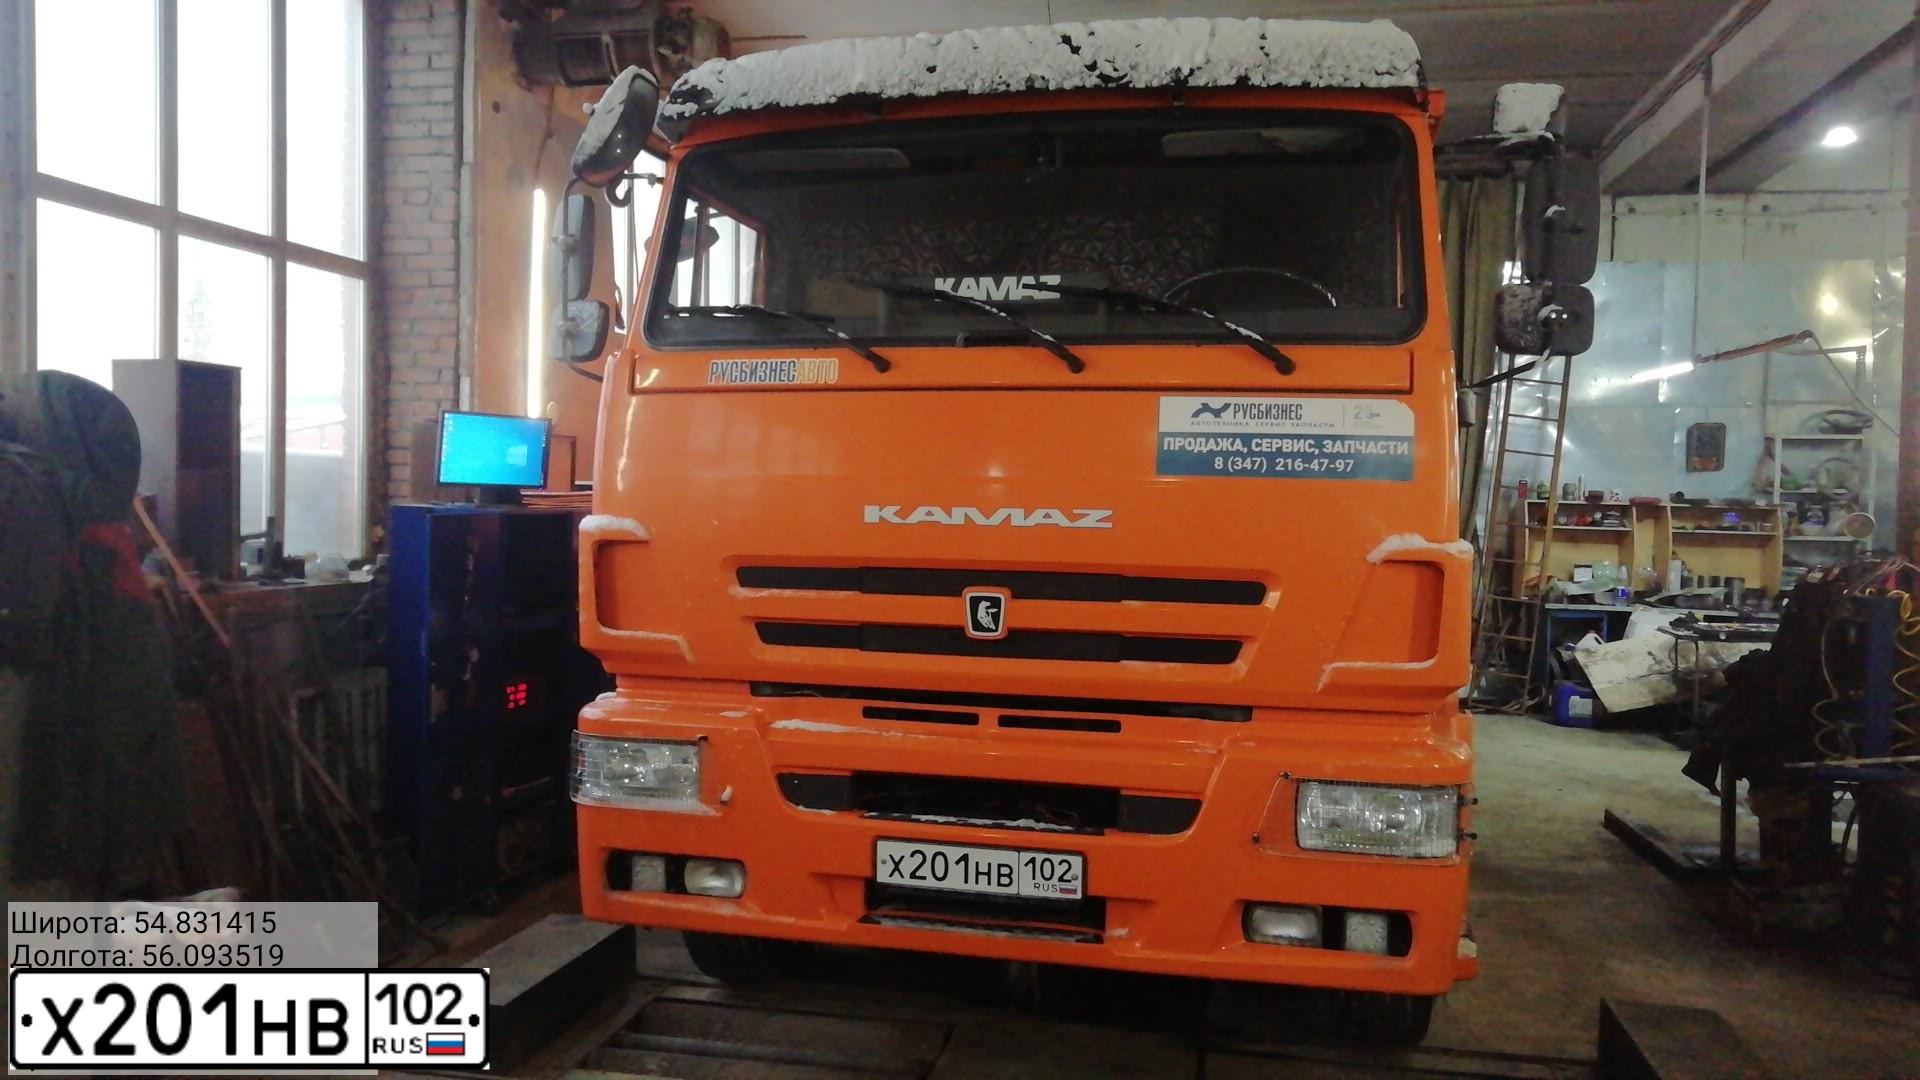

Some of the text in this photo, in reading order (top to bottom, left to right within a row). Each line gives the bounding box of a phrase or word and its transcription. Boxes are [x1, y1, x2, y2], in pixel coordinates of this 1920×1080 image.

[1233, 403, 1303, 420] РУСБИЗНЕС
[1163, 437, 1409, 455] ПРОДАЖА, СЕРВИС, ЗАПЧАСТИ
[1214, 457, 1354, 473] 8 (347) 216-47-97
[864, 505, 1113, 529] KAMAZ
[1023, 856, 1072, 883] 102
[1033, 882, 1058, 893] RUS
